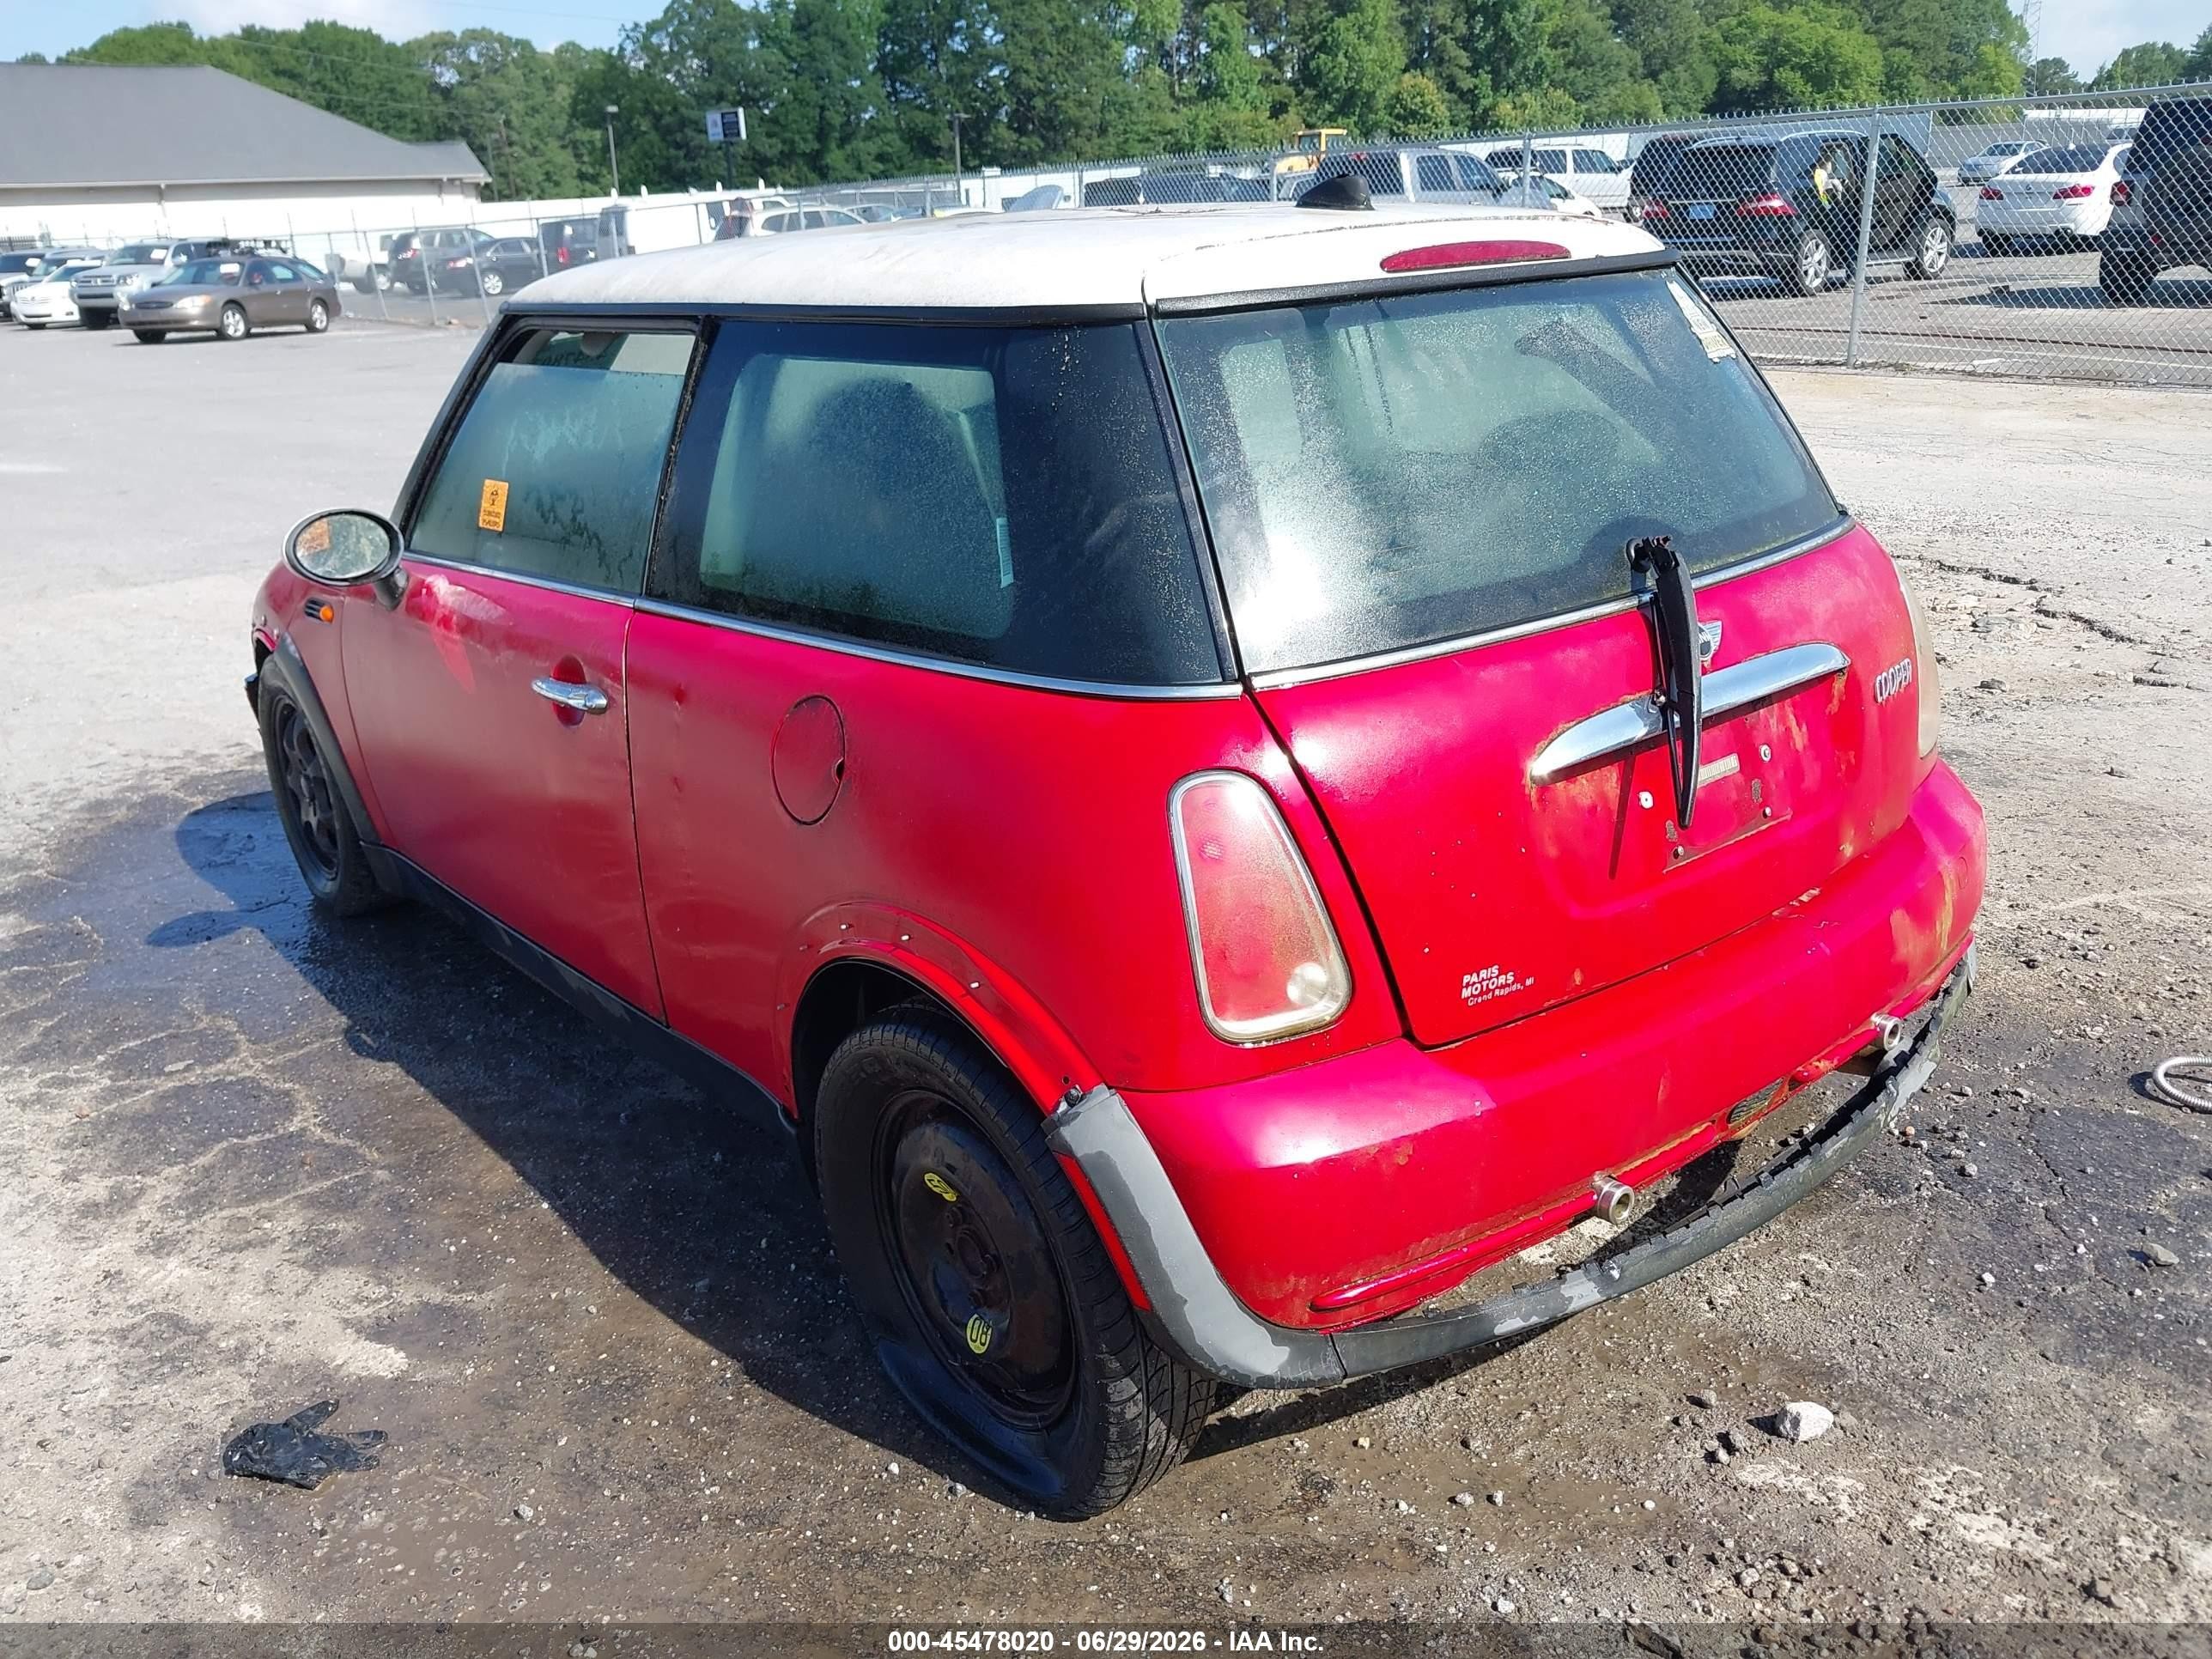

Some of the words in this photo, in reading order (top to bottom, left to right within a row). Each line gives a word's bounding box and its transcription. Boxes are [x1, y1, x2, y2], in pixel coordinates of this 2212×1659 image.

[1875, 658, 1912, 702] COOPER
[1462, 965, 1499, 987] PARIS
[1462, 972, 1515, 999] MOTORS
[1468, 992, 1492, 1006] Grand
[1494, 982, 1523, 997] Rapids,
